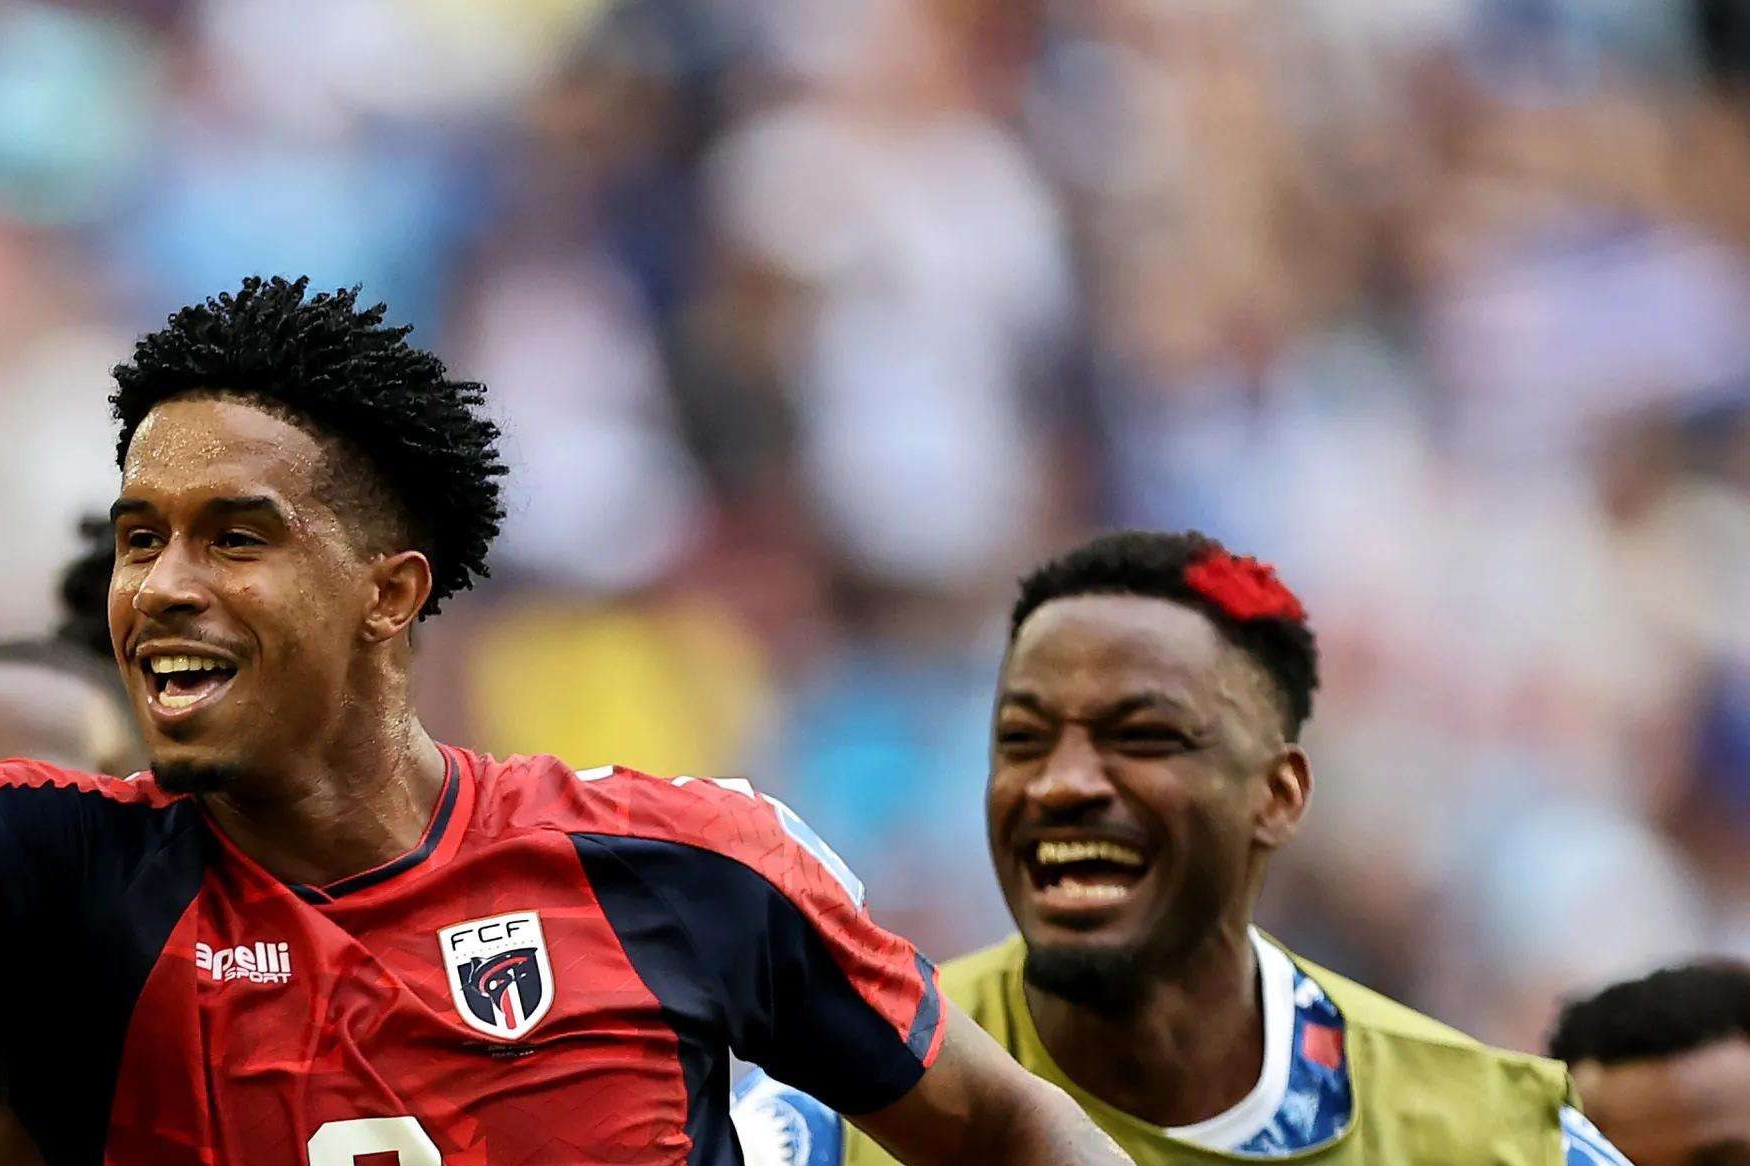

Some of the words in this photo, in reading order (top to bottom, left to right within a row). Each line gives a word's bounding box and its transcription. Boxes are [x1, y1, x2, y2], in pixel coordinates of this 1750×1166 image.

[451, 919, 530, 951] FCF
[194, 941, 291, 981] apelli
[225, 966, 292, 984] SPORT
